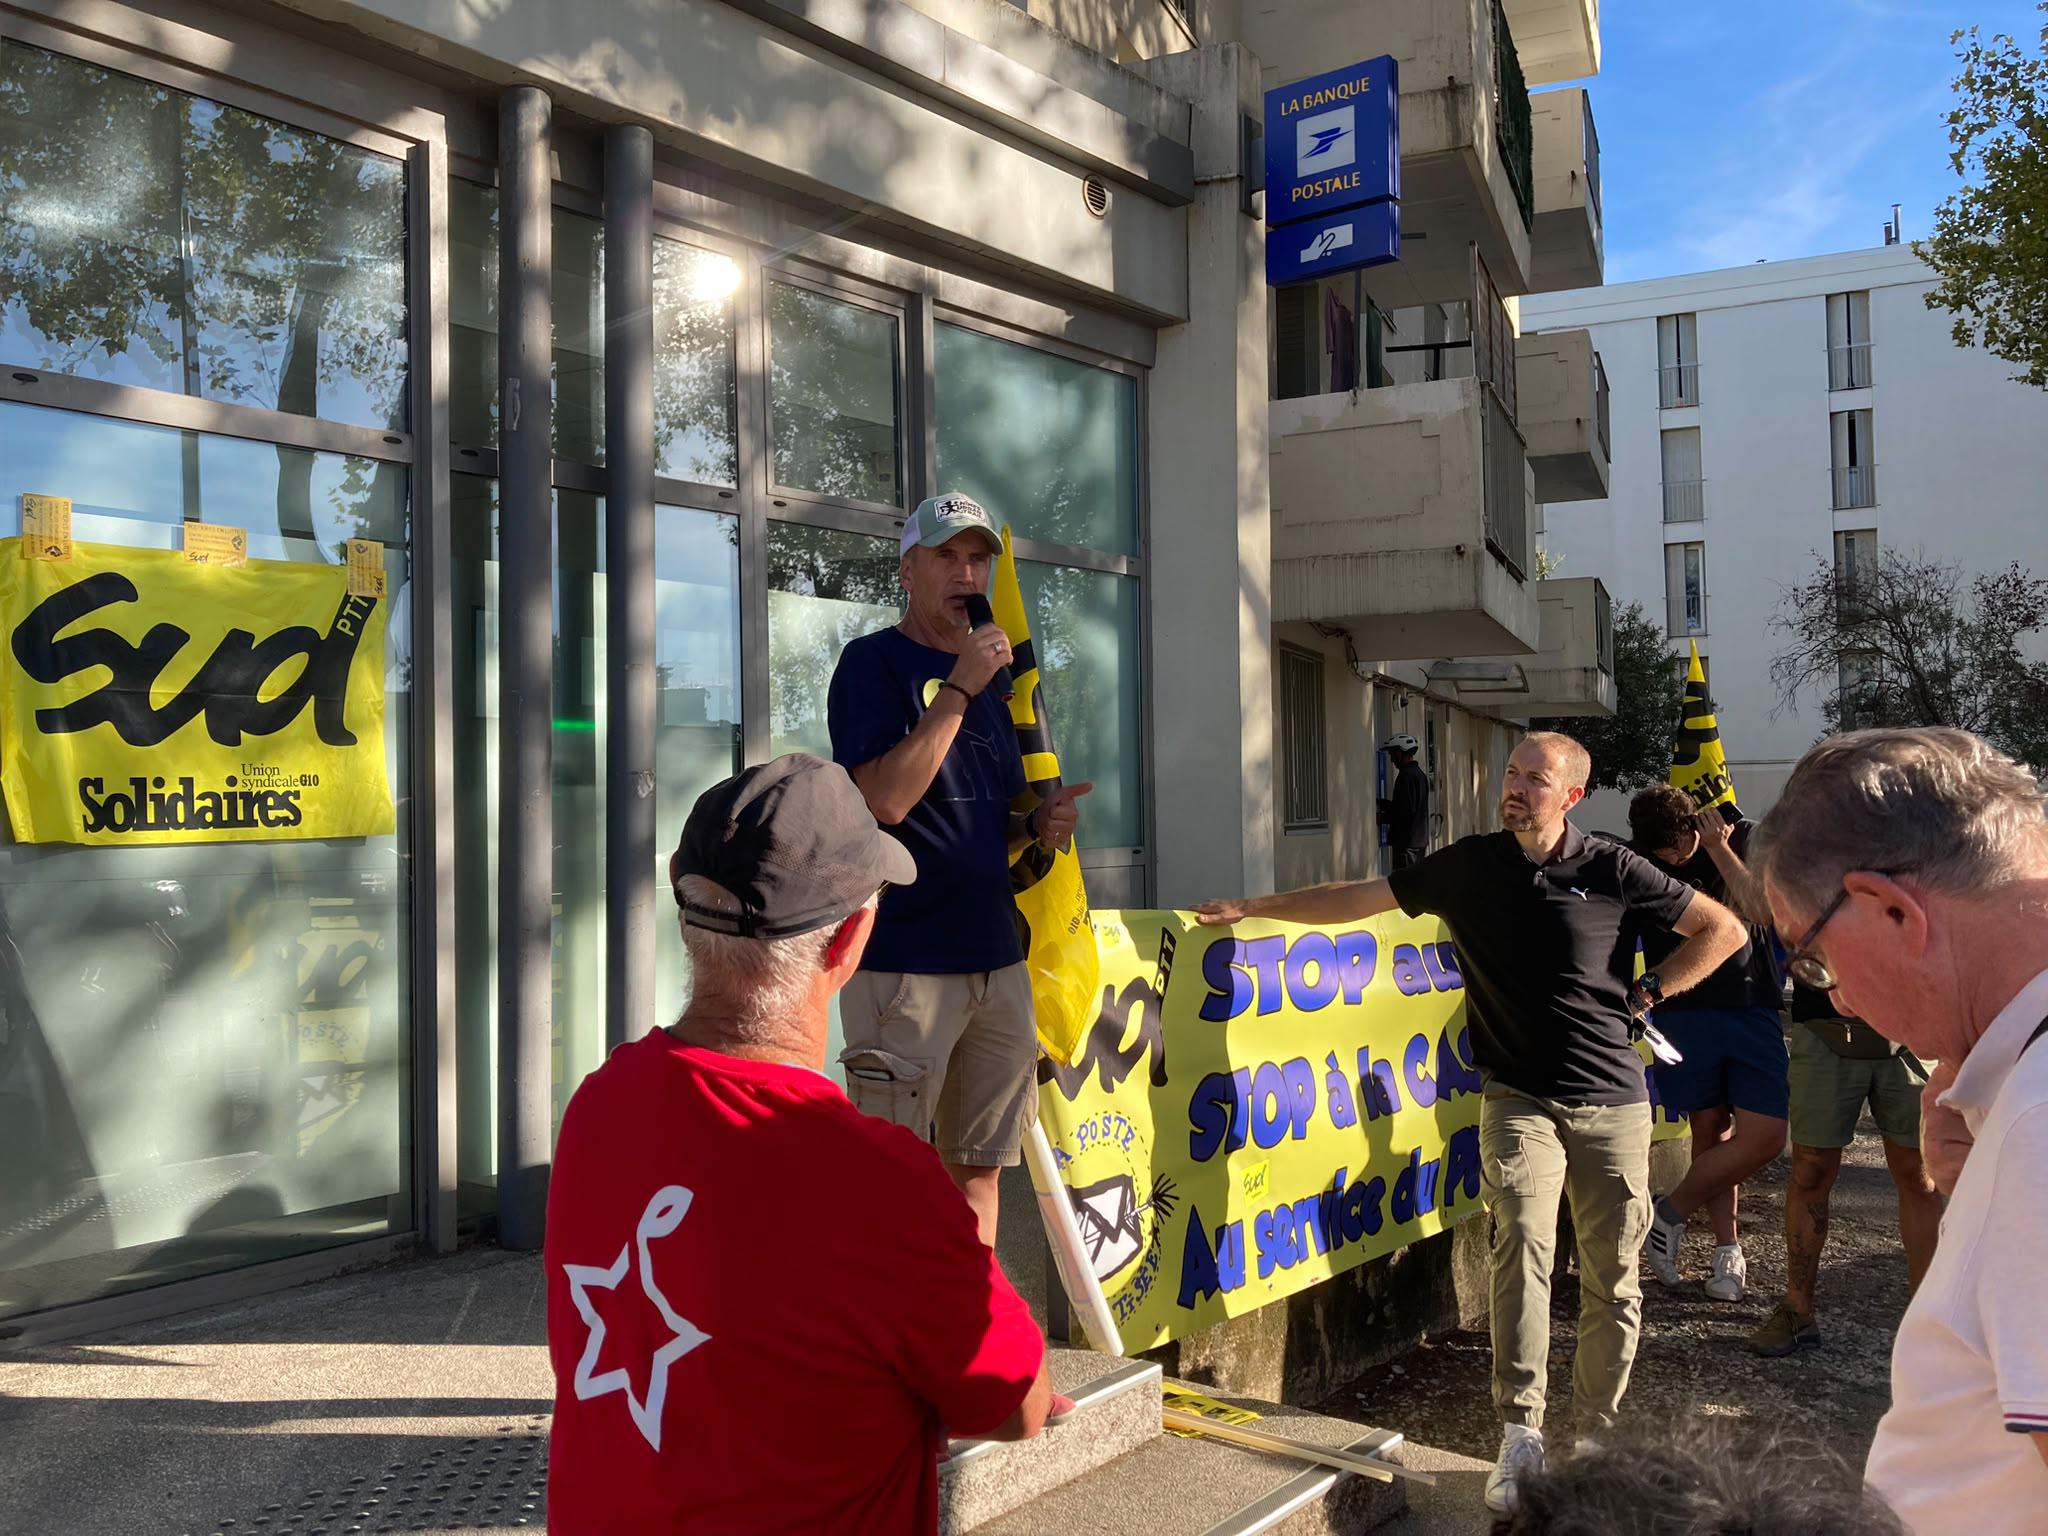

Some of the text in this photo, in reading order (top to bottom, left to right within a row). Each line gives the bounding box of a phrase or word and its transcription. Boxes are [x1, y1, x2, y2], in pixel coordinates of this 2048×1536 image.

[1280, 76, 1371, 116] LA BANQUE
[1292, 171, 1361, 203] POSTALE
[11, 571, 377, 748] Sud
[241, 762, 281, 776] Union
[79, 774, 302, 834] Solidaires
[1155, 932, 1176, 996] PTT
[1199, 929, 1465, 1022] STOP au
[1076, 1114, 1136, 1153] POSTE
[1189, 1057, 1316, 1162] STOP
[1327, 1051, 1357, 1129] à
[1357, 1045, 1401, 1122] la
[1177, 1205, 1247, 1310] Au
[1256, 1167, 1384, 1280] service
[1391, 1146, 1440, 1223] du
